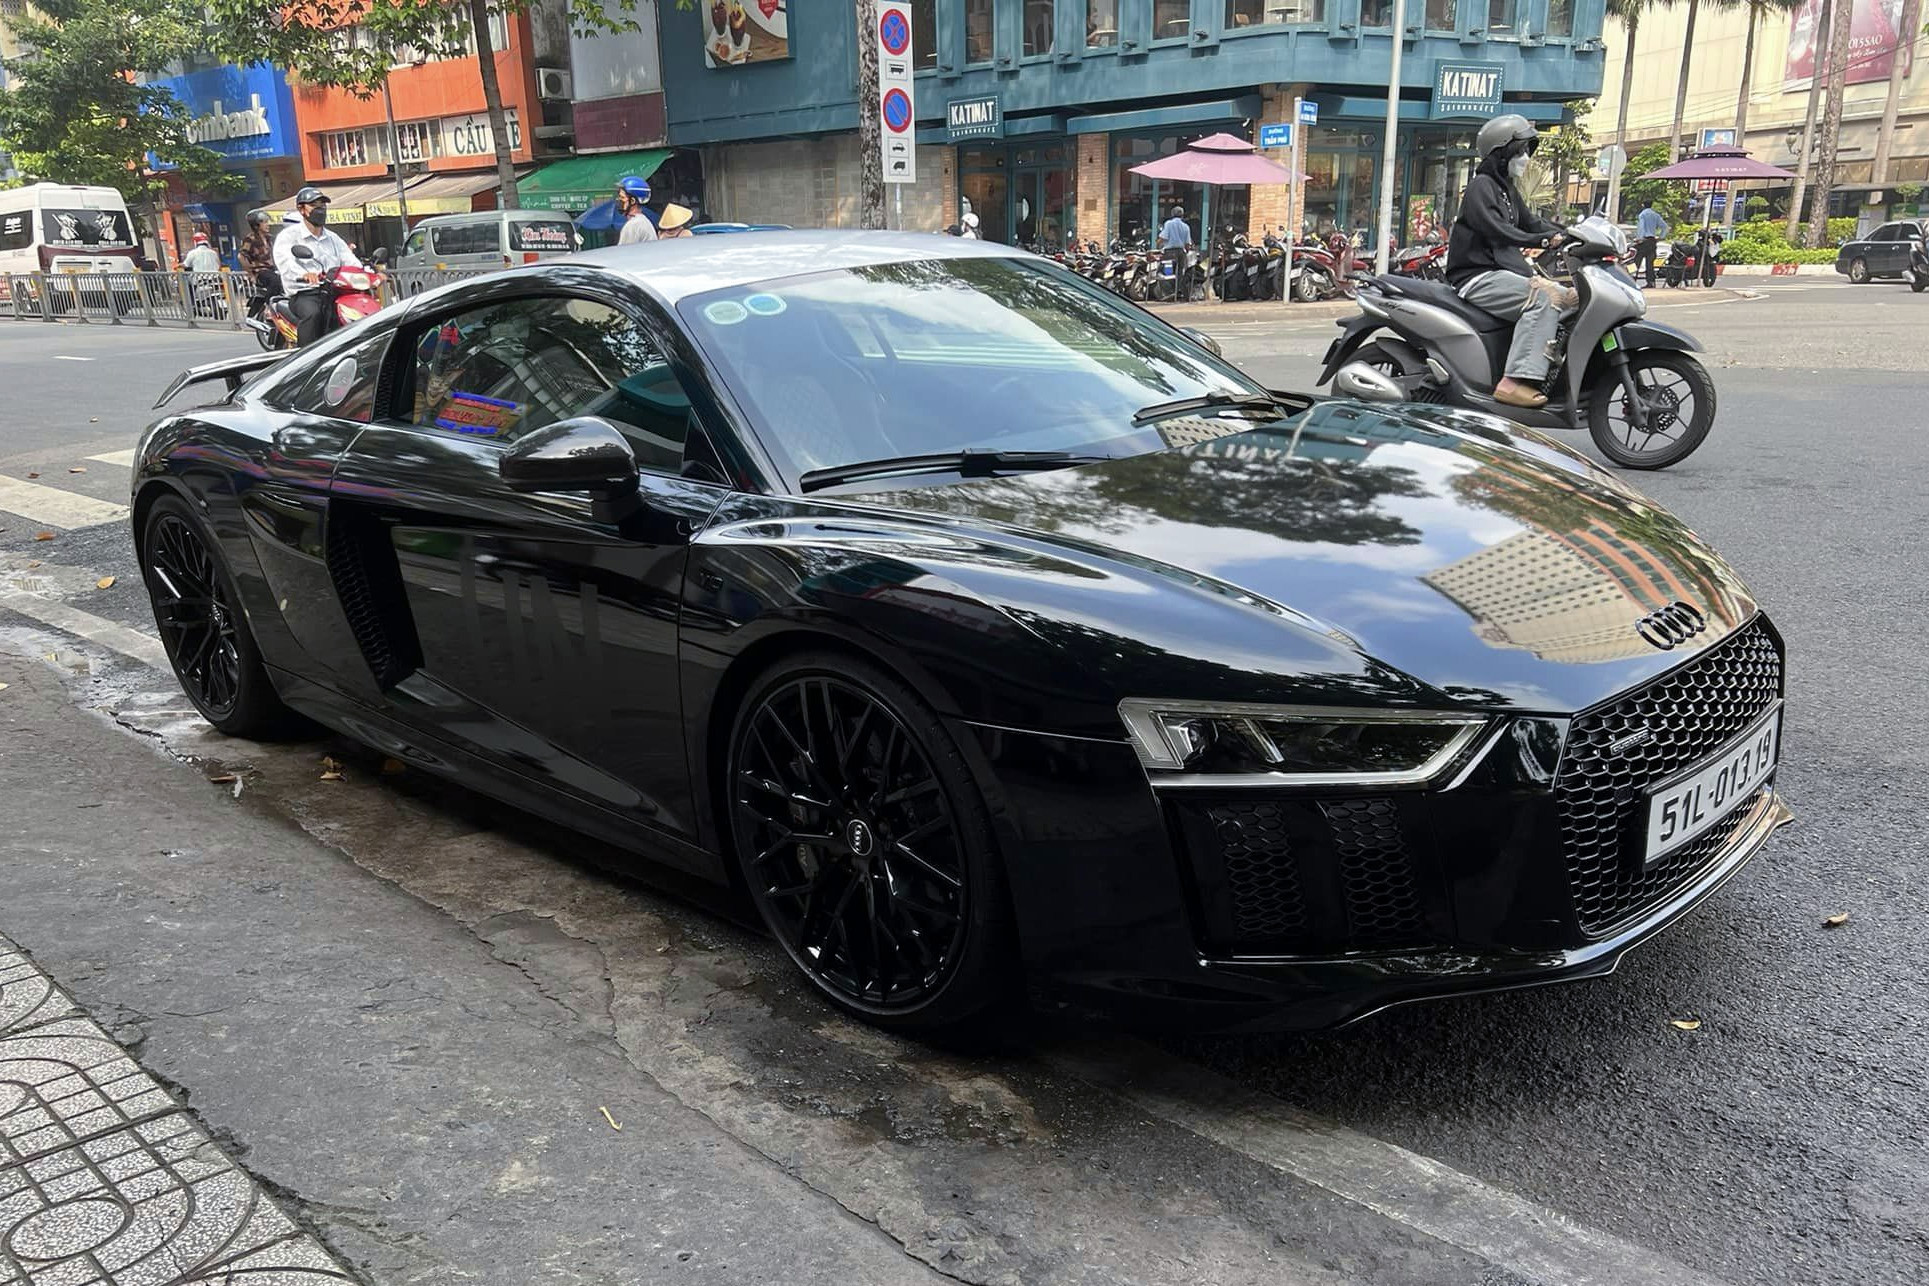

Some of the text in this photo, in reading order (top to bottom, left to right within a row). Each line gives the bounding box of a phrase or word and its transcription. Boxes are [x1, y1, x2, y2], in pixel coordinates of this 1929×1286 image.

[1442, 71, 1498, 98] KATINAT
[951, 101, 994, 125] KATINAT
[454, 115, 488, 155] CẦU
[1660, 728, 1771, 842] 51L-013.19
